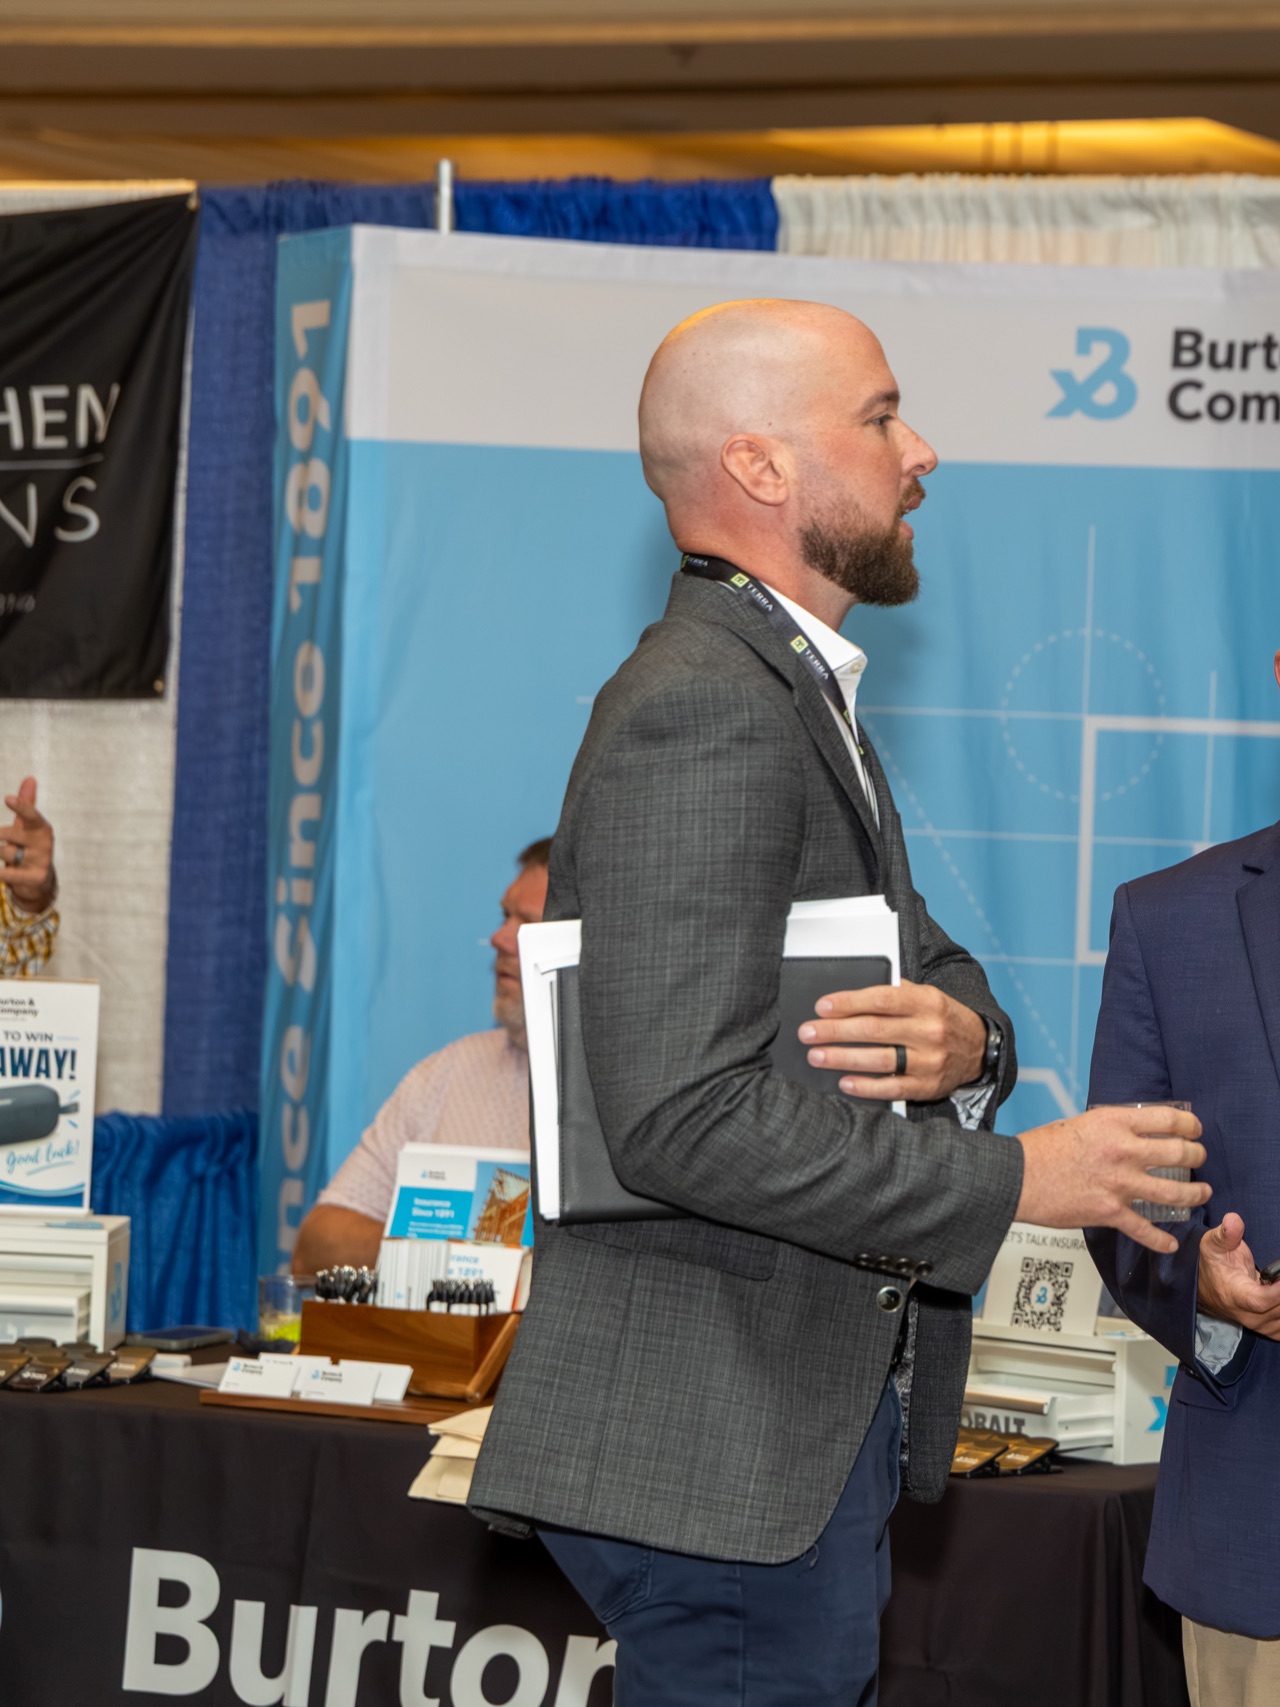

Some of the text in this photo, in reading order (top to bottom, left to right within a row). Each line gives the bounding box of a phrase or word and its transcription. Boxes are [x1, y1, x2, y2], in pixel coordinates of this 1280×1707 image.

[285, 299, 332, 615] 1891
[747, 583, 773, 613] TERRA
[804, 648, 829, 681] TERRA
[0, 1007, 39, 1018] ompany
[3, 1030, 54, 1043] TO WIN
[1025, 1232, 1049, 1247] TALK
[121, 1547, 618, 1707] Burton
